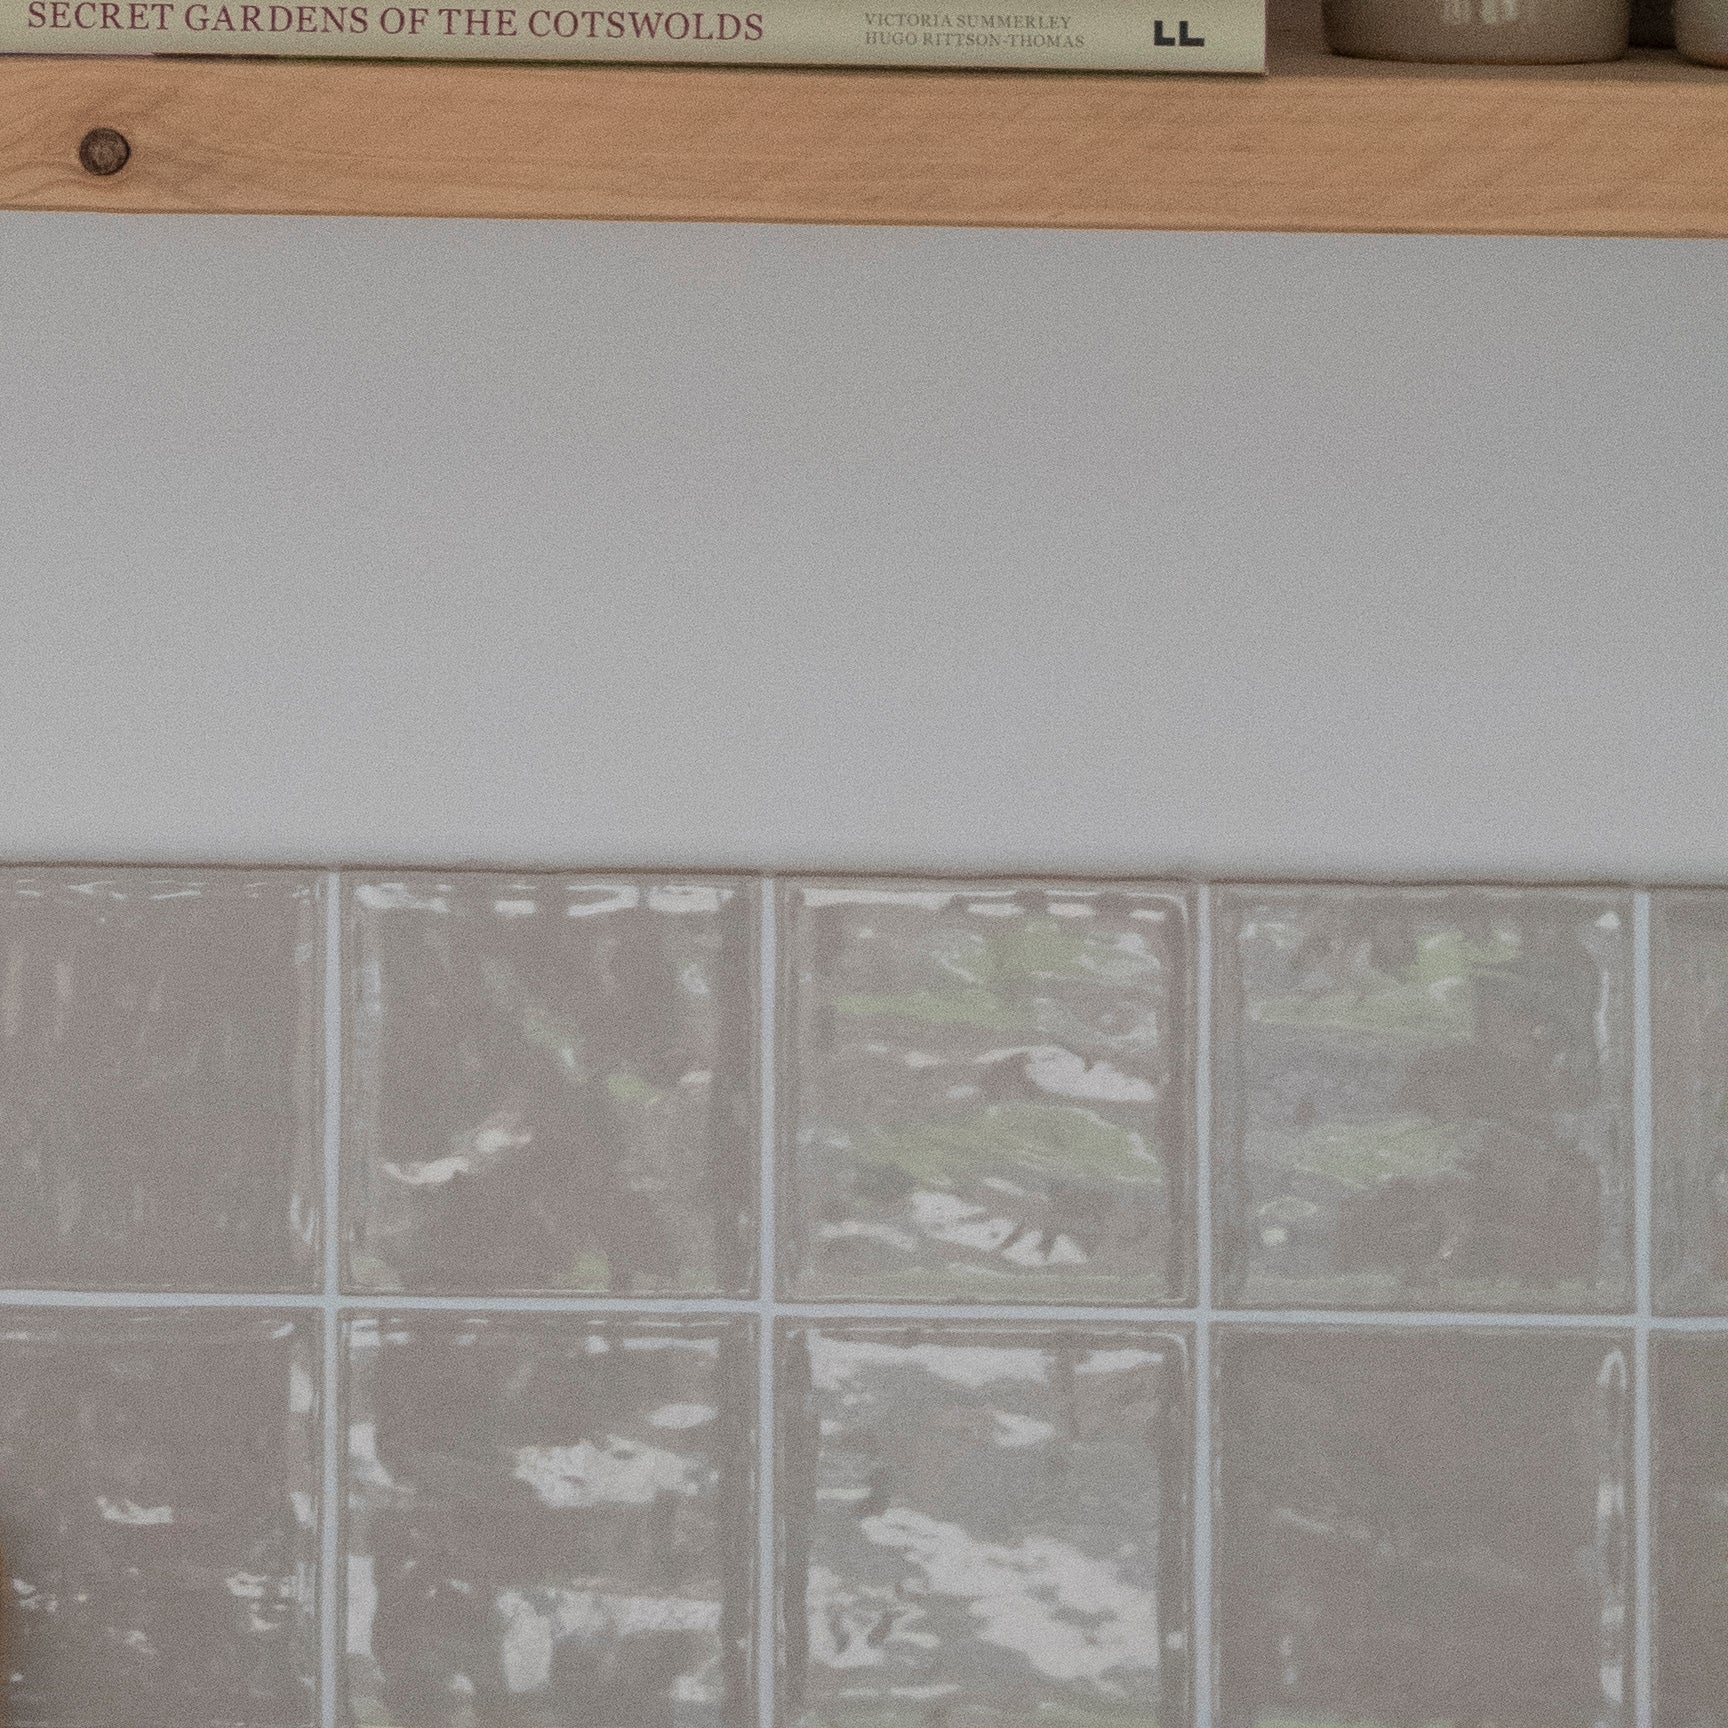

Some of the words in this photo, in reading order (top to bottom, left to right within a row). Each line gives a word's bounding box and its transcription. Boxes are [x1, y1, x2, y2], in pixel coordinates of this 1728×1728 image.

[28, 0, 175, 30] SECRET
[184, 3, 369, 33] GARDENS
[379, 7, 429, 35] OF
[438, 8, 518, 37] THE
[528, 9, 764, 41] COTSWOLDS
[864, 12, 953, 28] VICTORIA
[956, 14, 1071, 30] SUMMERLEY
[864, 31, 919, 46] HUGO
[921, 33, 1085, 48] RITTSON-THOMAS
